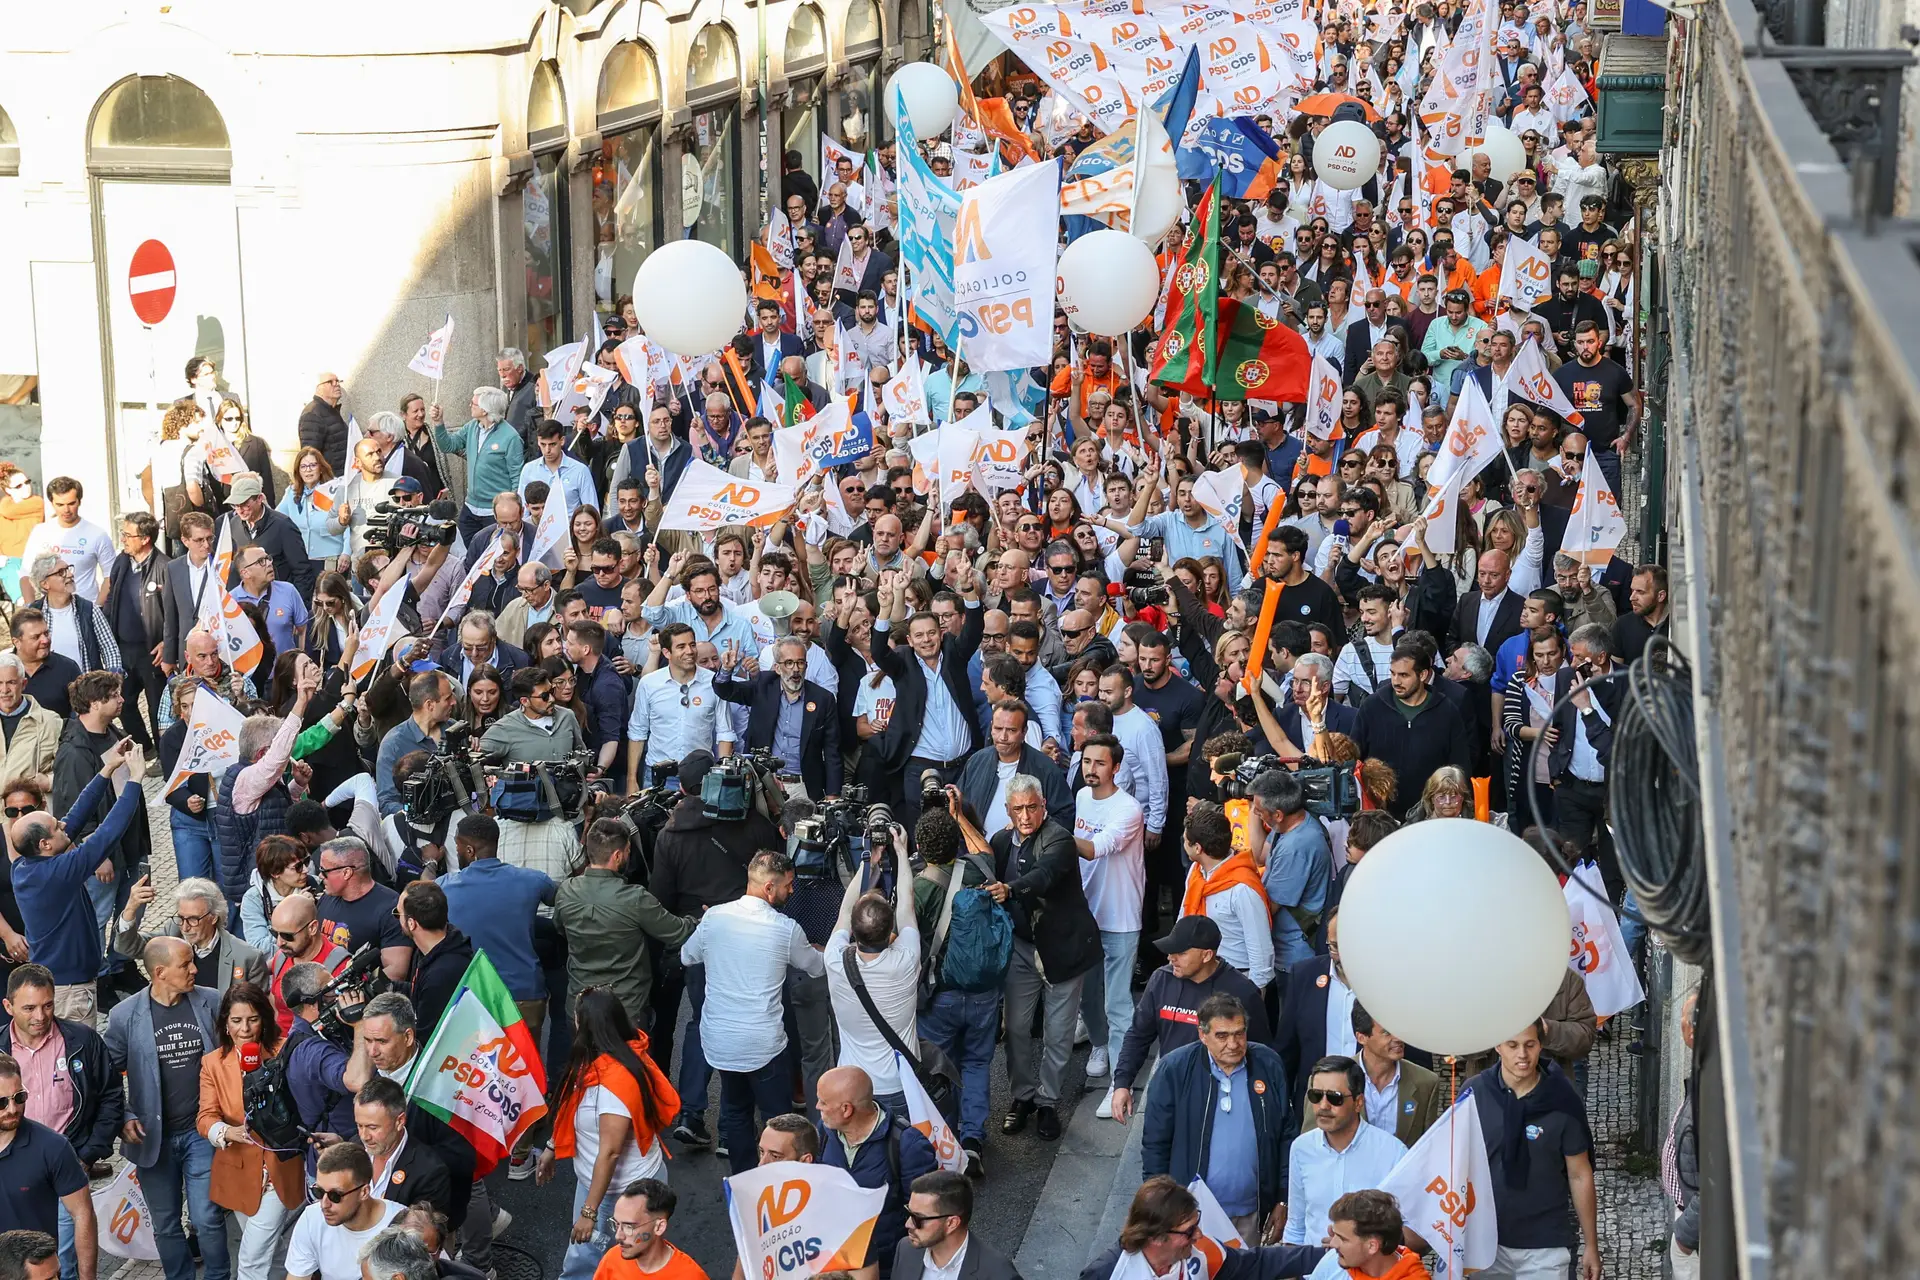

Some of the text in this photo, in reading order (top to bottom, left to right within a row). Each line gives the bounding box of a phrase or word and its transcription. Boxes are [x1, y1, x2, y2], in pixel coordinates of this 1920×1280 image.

[1596, 0, 1620, 10] Oca
[1112, 22, 1139, 45] AD
[1046, 41, 1071, 64] AD
[1209, 37, 1236, 61] AD
[1208, 53, 1256, 77] PSD/CDS
[1334, 145, 1356, 158] AD
[1517, 256, 1549, 281] AD
[712, 483, 761, 508] AD
[164, 1022, 182, 1031] YOUR
[168, 1033, 183, 1041] THE
[244, 1055, 258, 1063] CNN
[756, 1179, 812, 1239] AD
